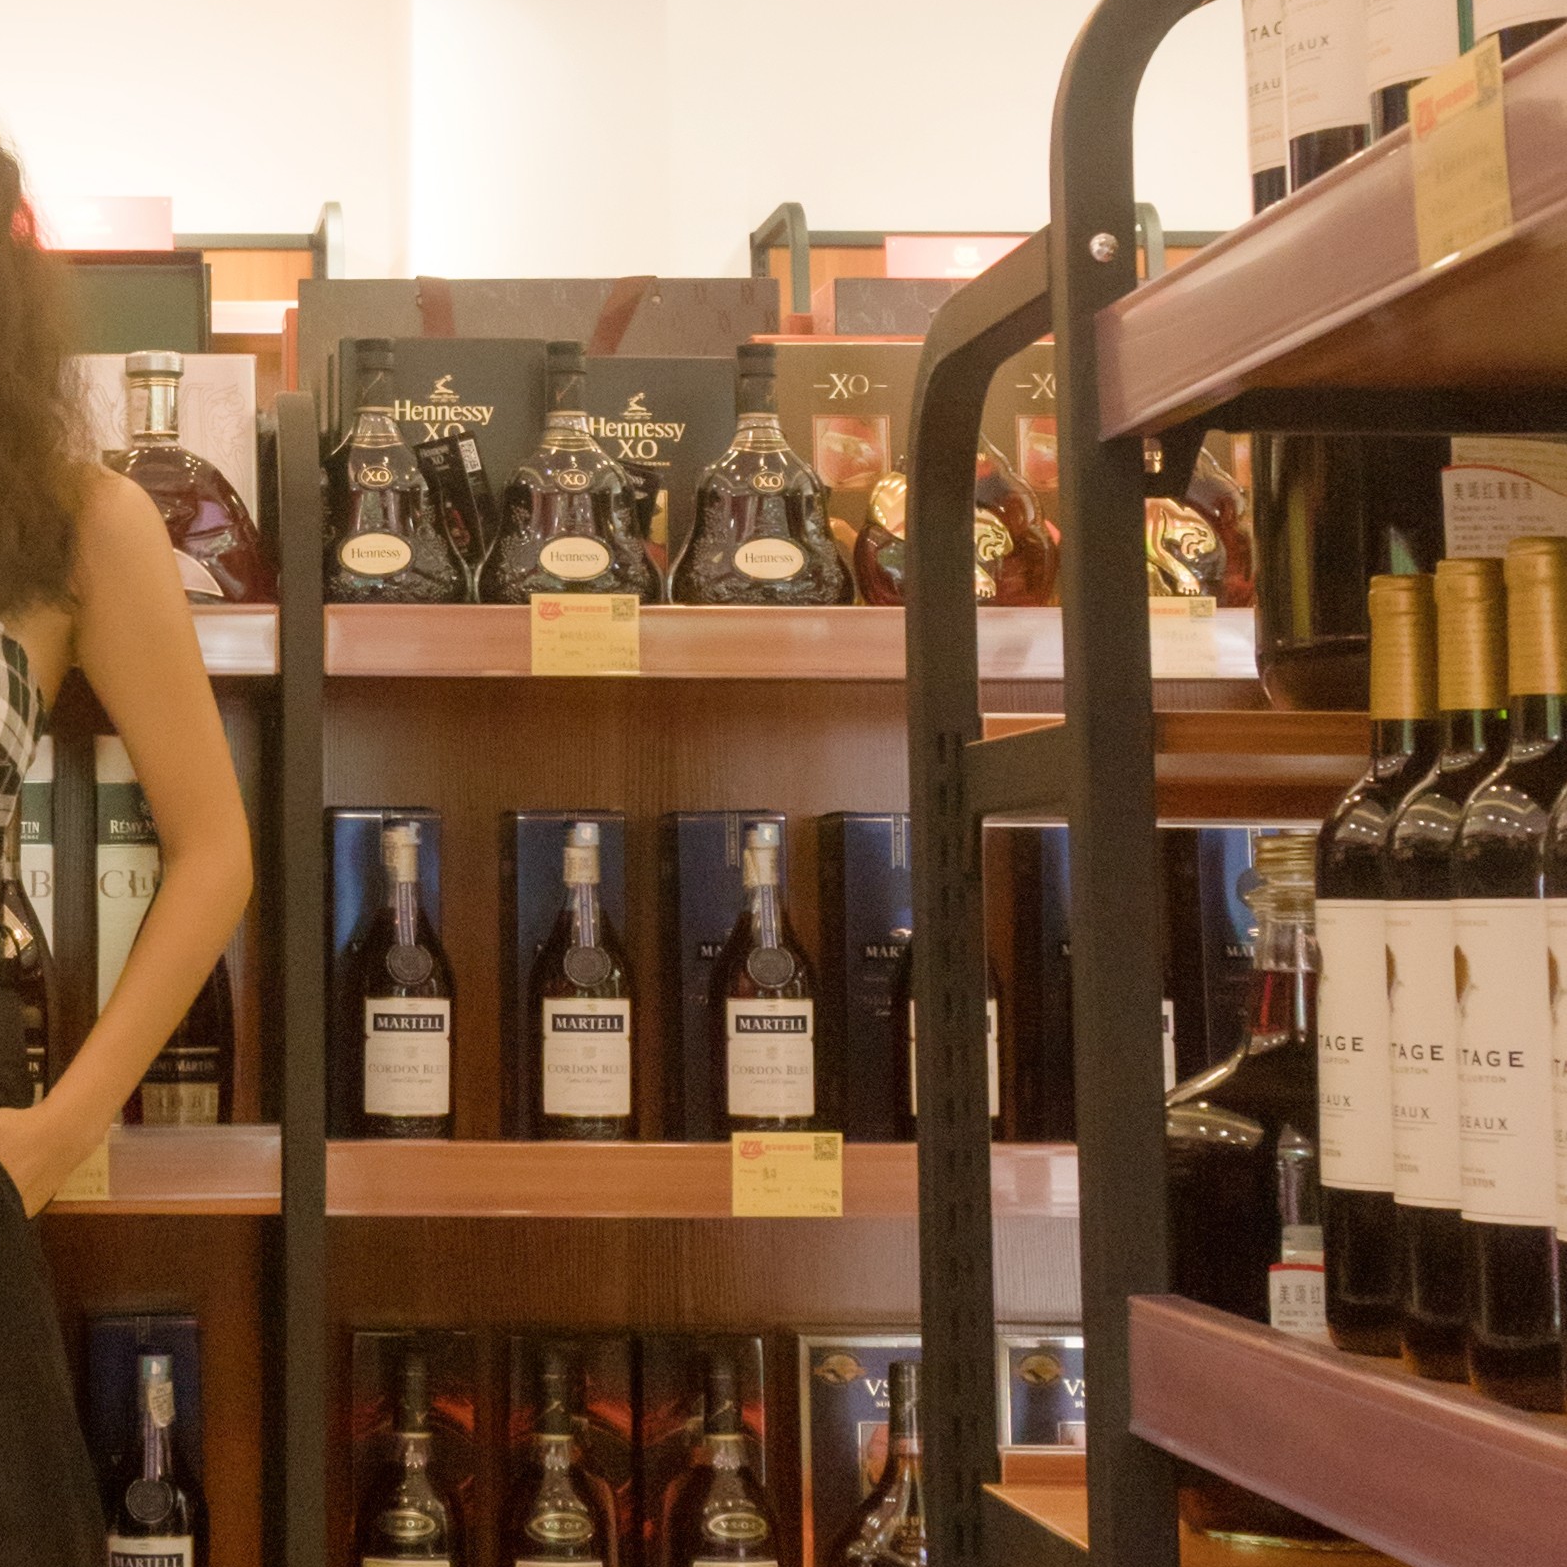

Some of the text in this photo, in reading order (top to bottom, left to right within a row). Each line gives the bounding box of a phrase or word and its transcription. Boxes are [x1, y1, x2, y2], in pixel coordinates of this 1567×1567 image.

[828, 373, 870, 400] XO
[1031, 373, 1057, 399] X
[394, 400, 494, 425] Hennessy
[589, 416, 686, 442] Hennessy
[351, 548, 403, 560] Hennessy
[550, 551, 601, 563] Hennessy
[745, 552, 794, 565] Hennessy
[376, 1016, 442, 1030] MARTELL
[555, 1016, 622, 1030] MARTELL
[738, 1018, 806, 1032] MARTELL
[367, 1063, 419, 1075] CORDON
[547, 1064, 598, 1075] CORDON
[731, 1064, 782, 1076] CORDON
